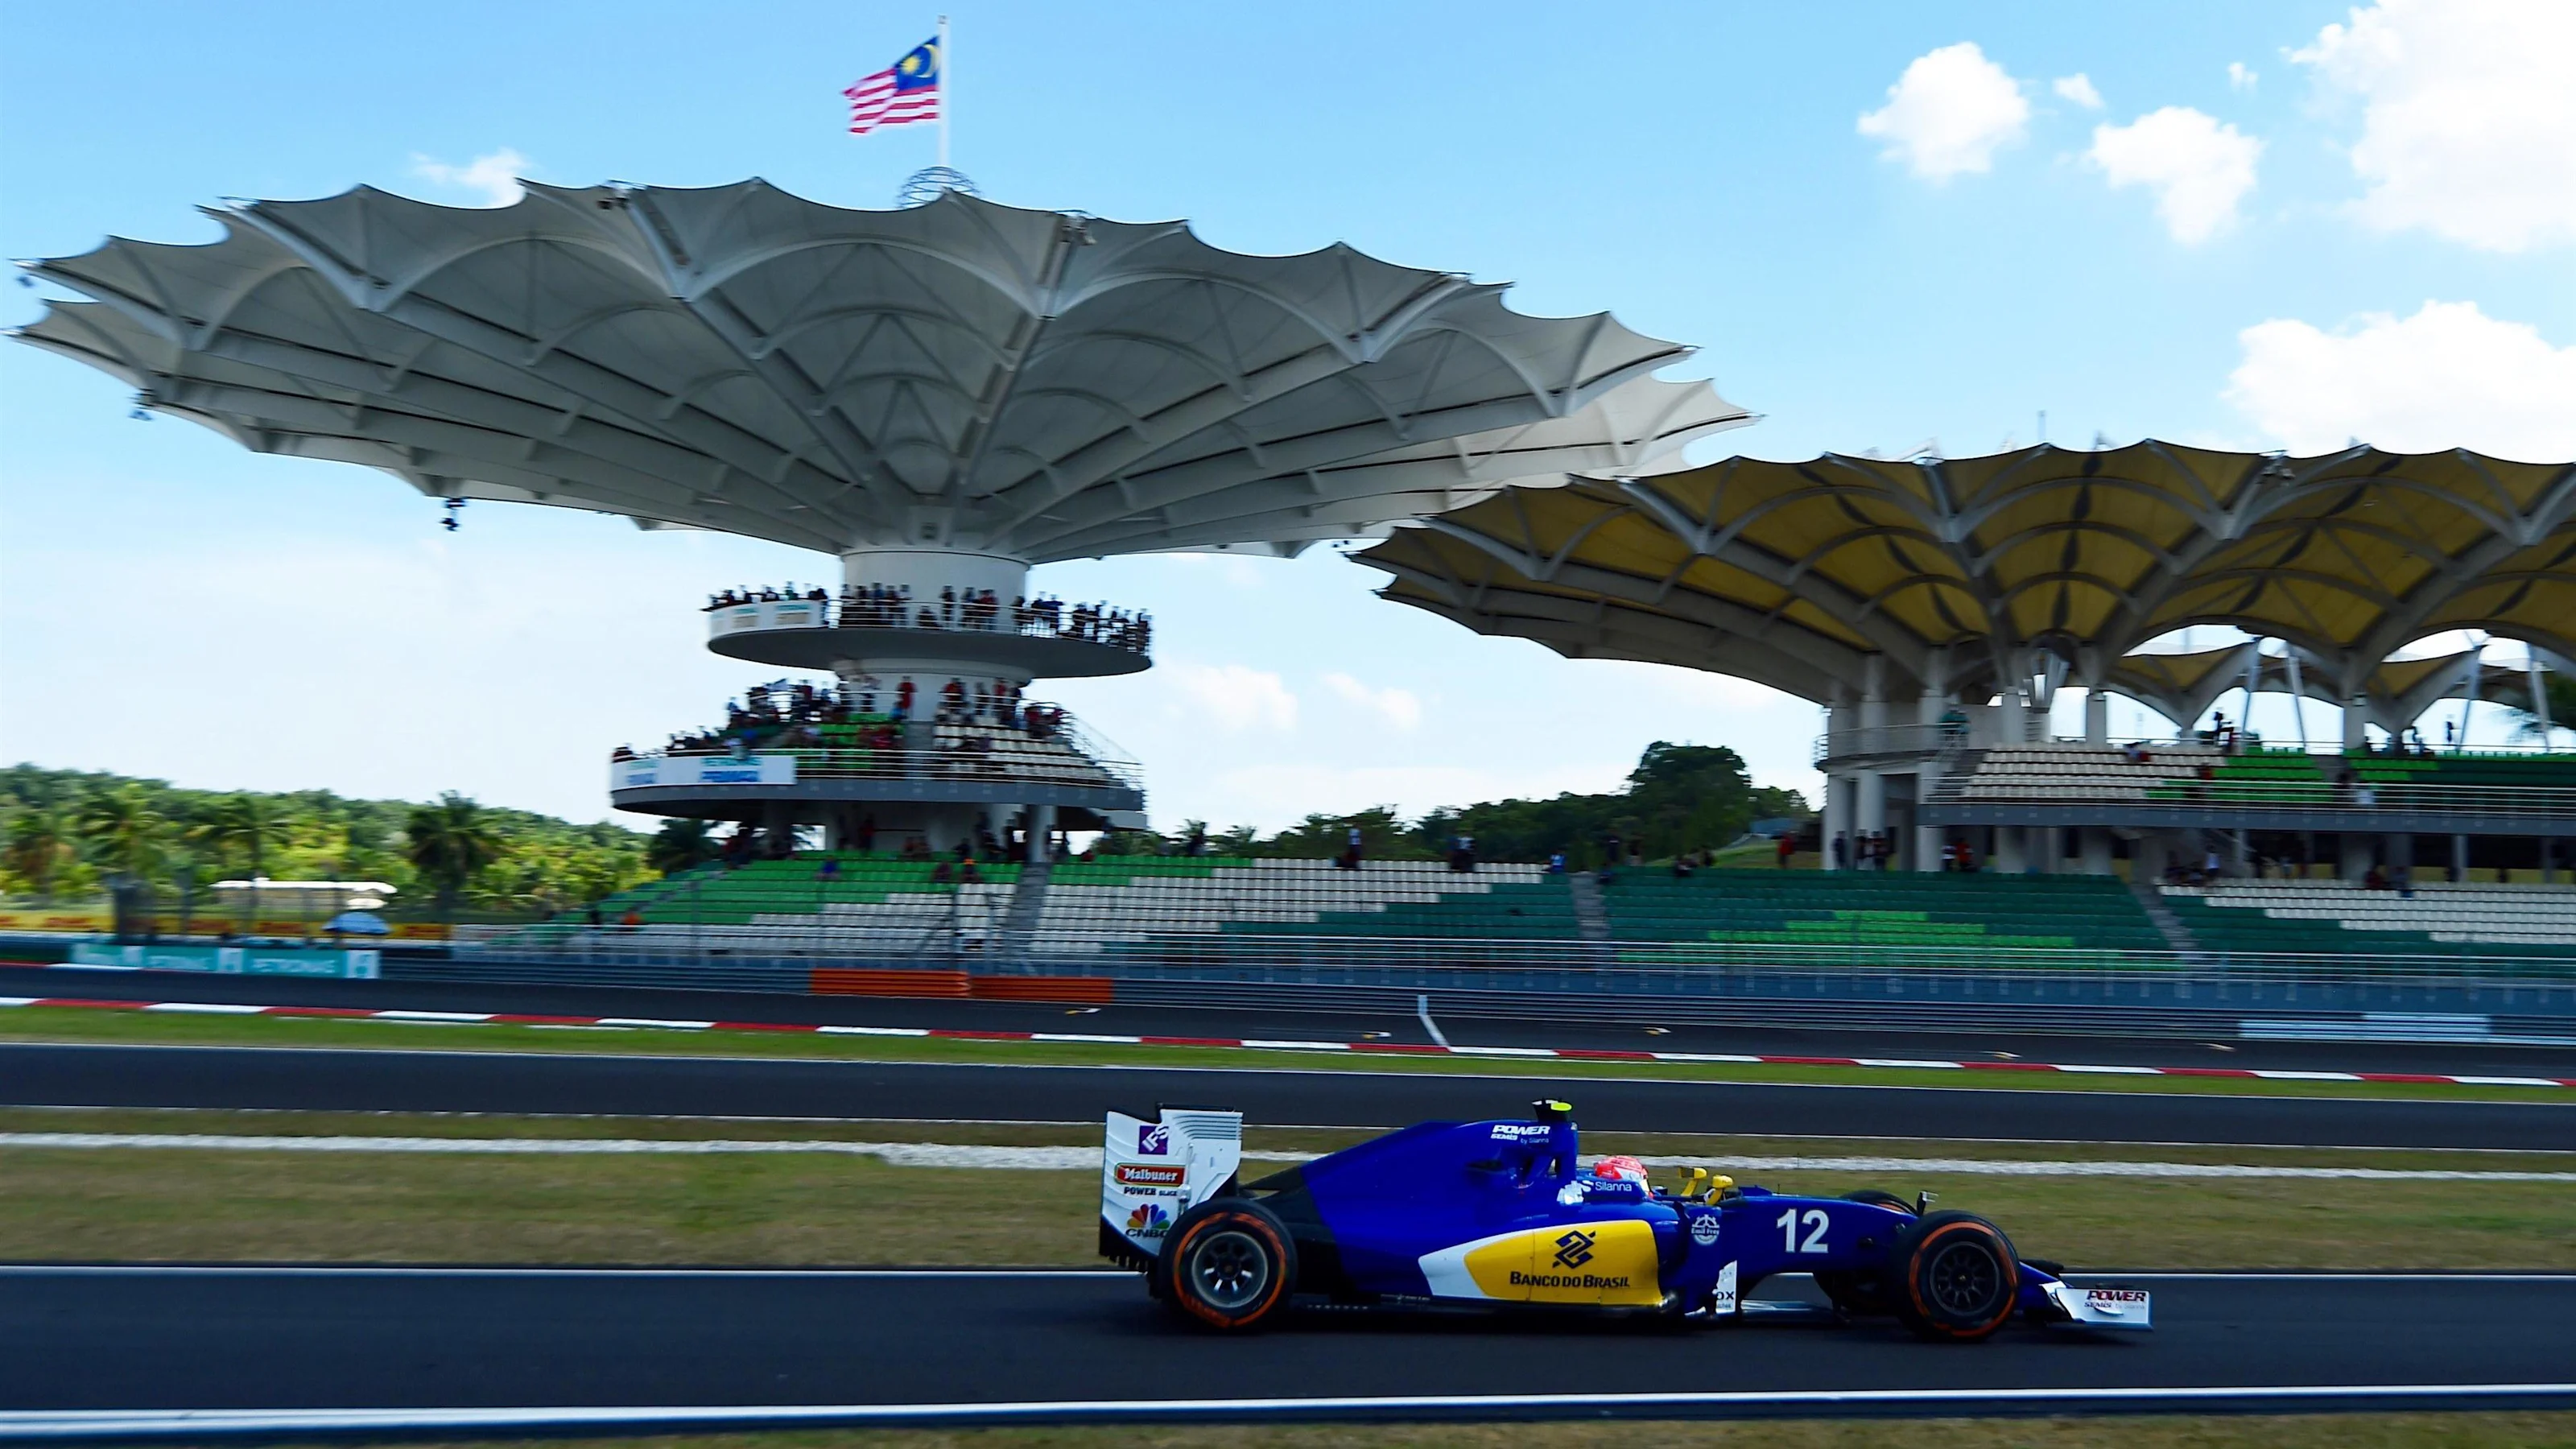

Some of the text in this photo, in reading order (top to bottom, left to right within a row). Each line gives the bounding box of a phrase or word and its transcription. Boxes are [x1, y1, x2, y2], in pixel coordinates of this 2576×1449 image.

[1492, 1125, 1550, 1134] POWER
[1141, 1125, 1169, 1152] IFS
[1124, 1168, 1179, 1183] Malbuner
[1124, 1187, 1157, 1195] POWER
[1595, 1181, 1633, 1191] Silanna
[1776, 1208, 1829, 1253] 12
[1509, 1271, 1630, 1287] BANCO DO BRASIL
[2087, 1290, 2145, 1301] POWER
